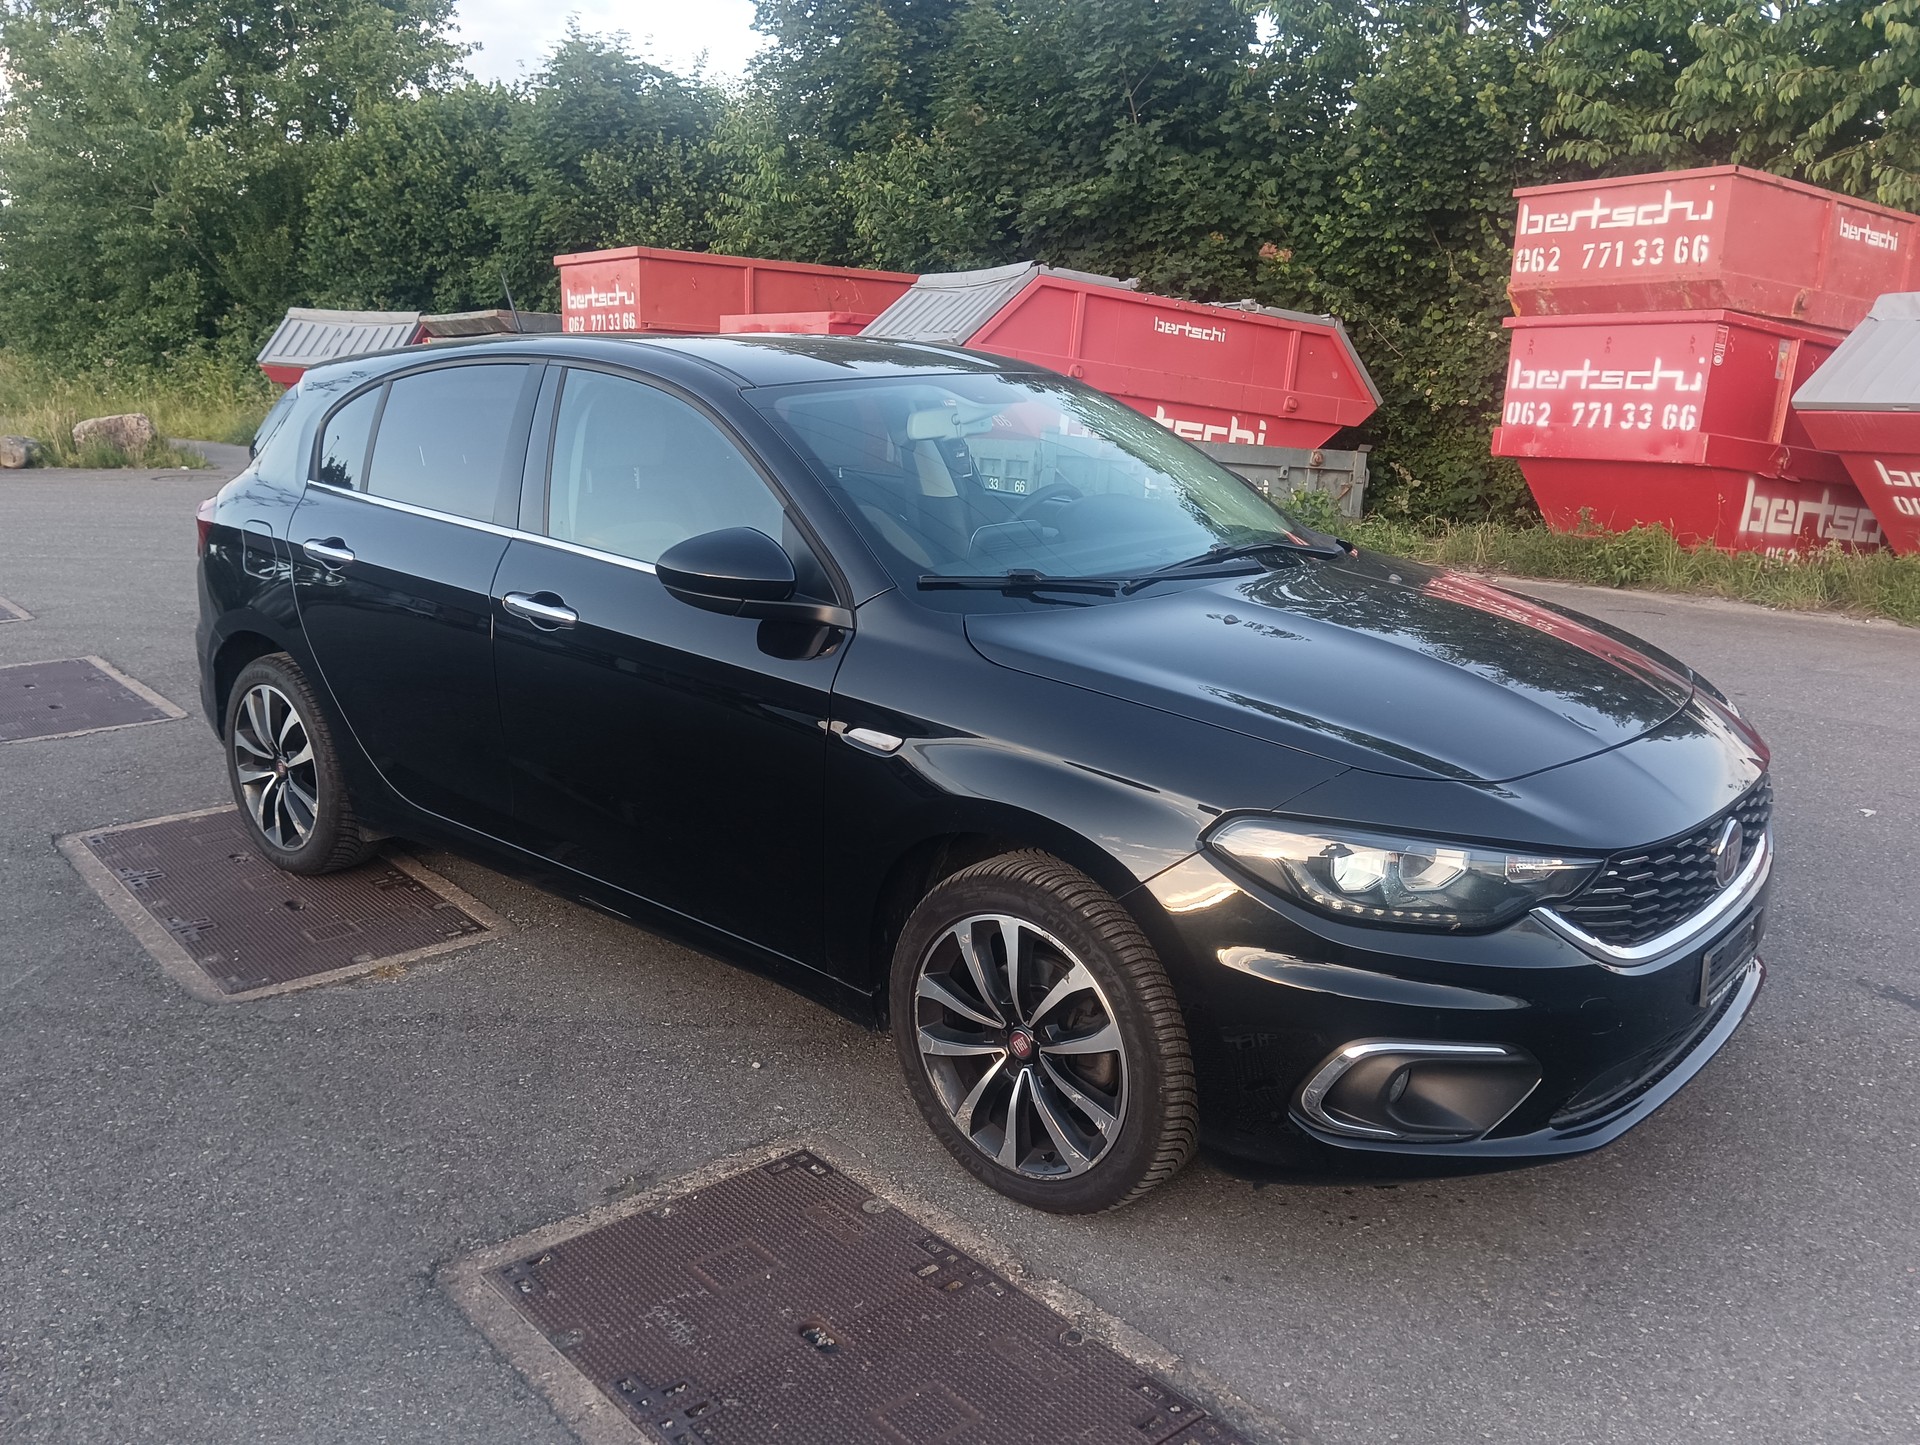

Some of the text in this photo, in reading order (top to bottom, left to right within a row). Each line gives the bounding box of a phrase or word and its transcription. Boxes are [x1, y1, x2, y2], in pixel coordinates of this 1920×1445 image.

[1520, 184, 1716, 235] bertschi
[1839, 216, 1899, 251] bertschi
[1515, 234, 1710, 273] 062 771 33 66
[566, 282, 635, 310] bertschi
[568, 312, 636, 332] 062 771 33 66
[1154, 315, 1227, 343] bertschi
[1511, 356, 1706, 392] bertschi
[1505, 401, 1697, 432] 062 771 33 66
[988, 477, 1025, 493] 33 66
[1013, 1036, 1029, 1053] FIAT
